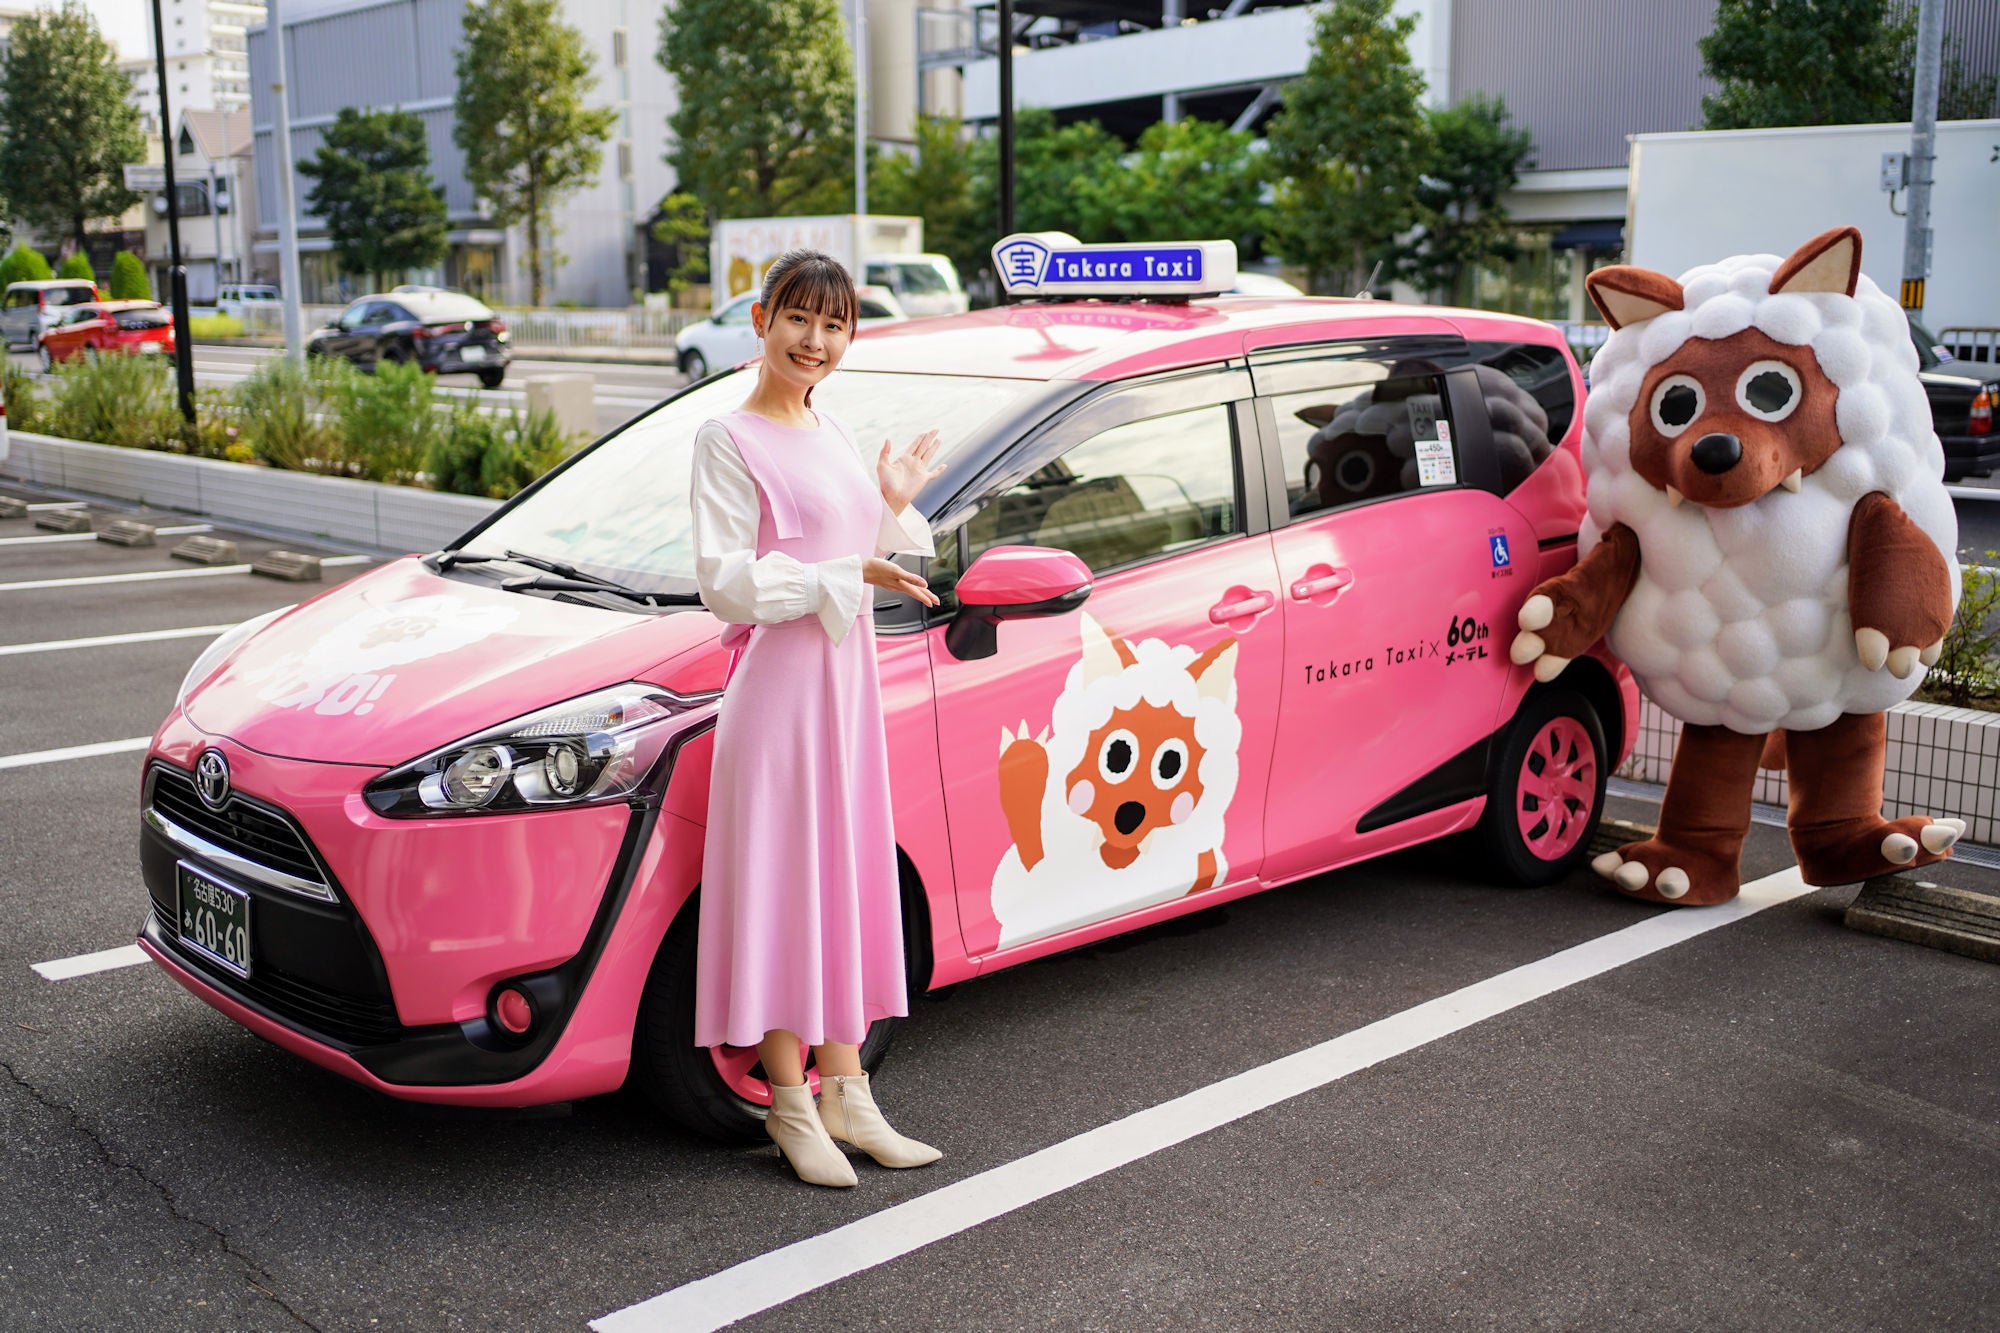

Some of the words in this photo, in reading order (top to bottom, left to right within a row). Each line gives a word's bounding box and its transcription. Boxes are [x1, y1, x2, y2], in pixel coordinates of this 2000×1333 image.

[1009, 247, 1036, 277] 宝
[1055, 257, 1132, 279] Takara
[1144, 255, 1194, 277] Taxi
[1447, 615, 1489, 647] 60th
[1305, 657, 1374, 685] Takara
[1386, 640, 1424, 666] Taxi
[184, 909, 193, 930] あ
[195, 906, 247, 968] 60-60
